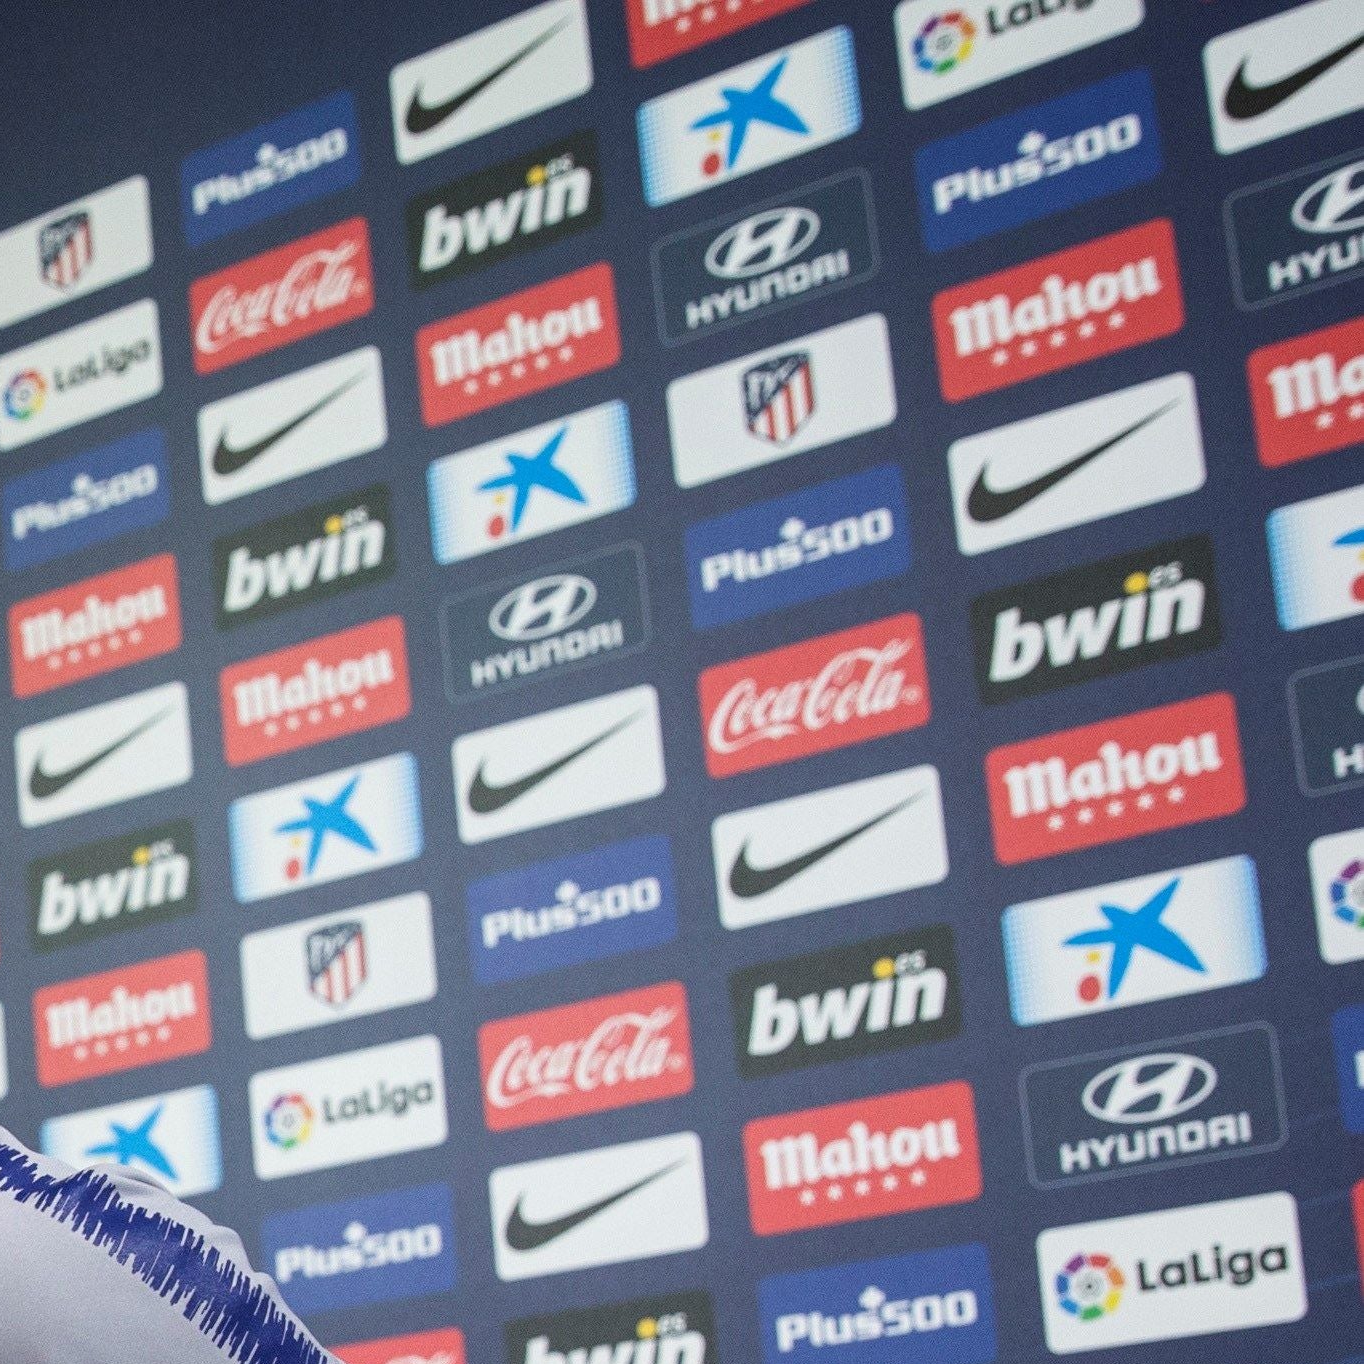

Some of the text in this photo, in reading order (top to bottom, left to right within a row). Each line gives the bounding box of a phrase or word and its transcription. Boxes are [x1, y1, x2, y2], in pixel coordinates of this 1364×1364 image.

[193, 127, 347, 215] Plus500
[933, 114, 1141, 214] Plus500
[420, 166, 590, 271] bwin
[687, 249, 850, 329] HYUNDAI
[950, 257, 1161, 356] Mahou
[430, 297, 602, 384] Mahou
[13, 465, 157, 539] Plus500
[225, 516, 384, 611] bwin
[702, 509, 893, 591] Plus500
[21, 585, 167, 658] Mahou
[472, 620, 623, 688] HYUNDAI
[990, 573, 1205, 682] bwin
[234, 649, 393, 726] Mahou
[708, 641, 906, 754] Coca-Cola
[1004, 733, 1221, 820] Mahou
[40, 846, 188, 934] bwin
[483, 879, 660, 948] Plus500
[47, 982, 196, 1049] Mahou
[749, 958, 946, 1056] bwin
[486, 1007, 672, 1109] Coca-Cola
[322, 1081, 435, 1125] LaLiga
[1060, 1112, 1252, 1173] HYUNDAI
[761, 1119, 959, 1191] Mahou
[277, 1223, 442, 1284] Plus500
[1136, 1244, 1289, 1294] LaLiga
[776, 1288, 977, 1352] Plus500
